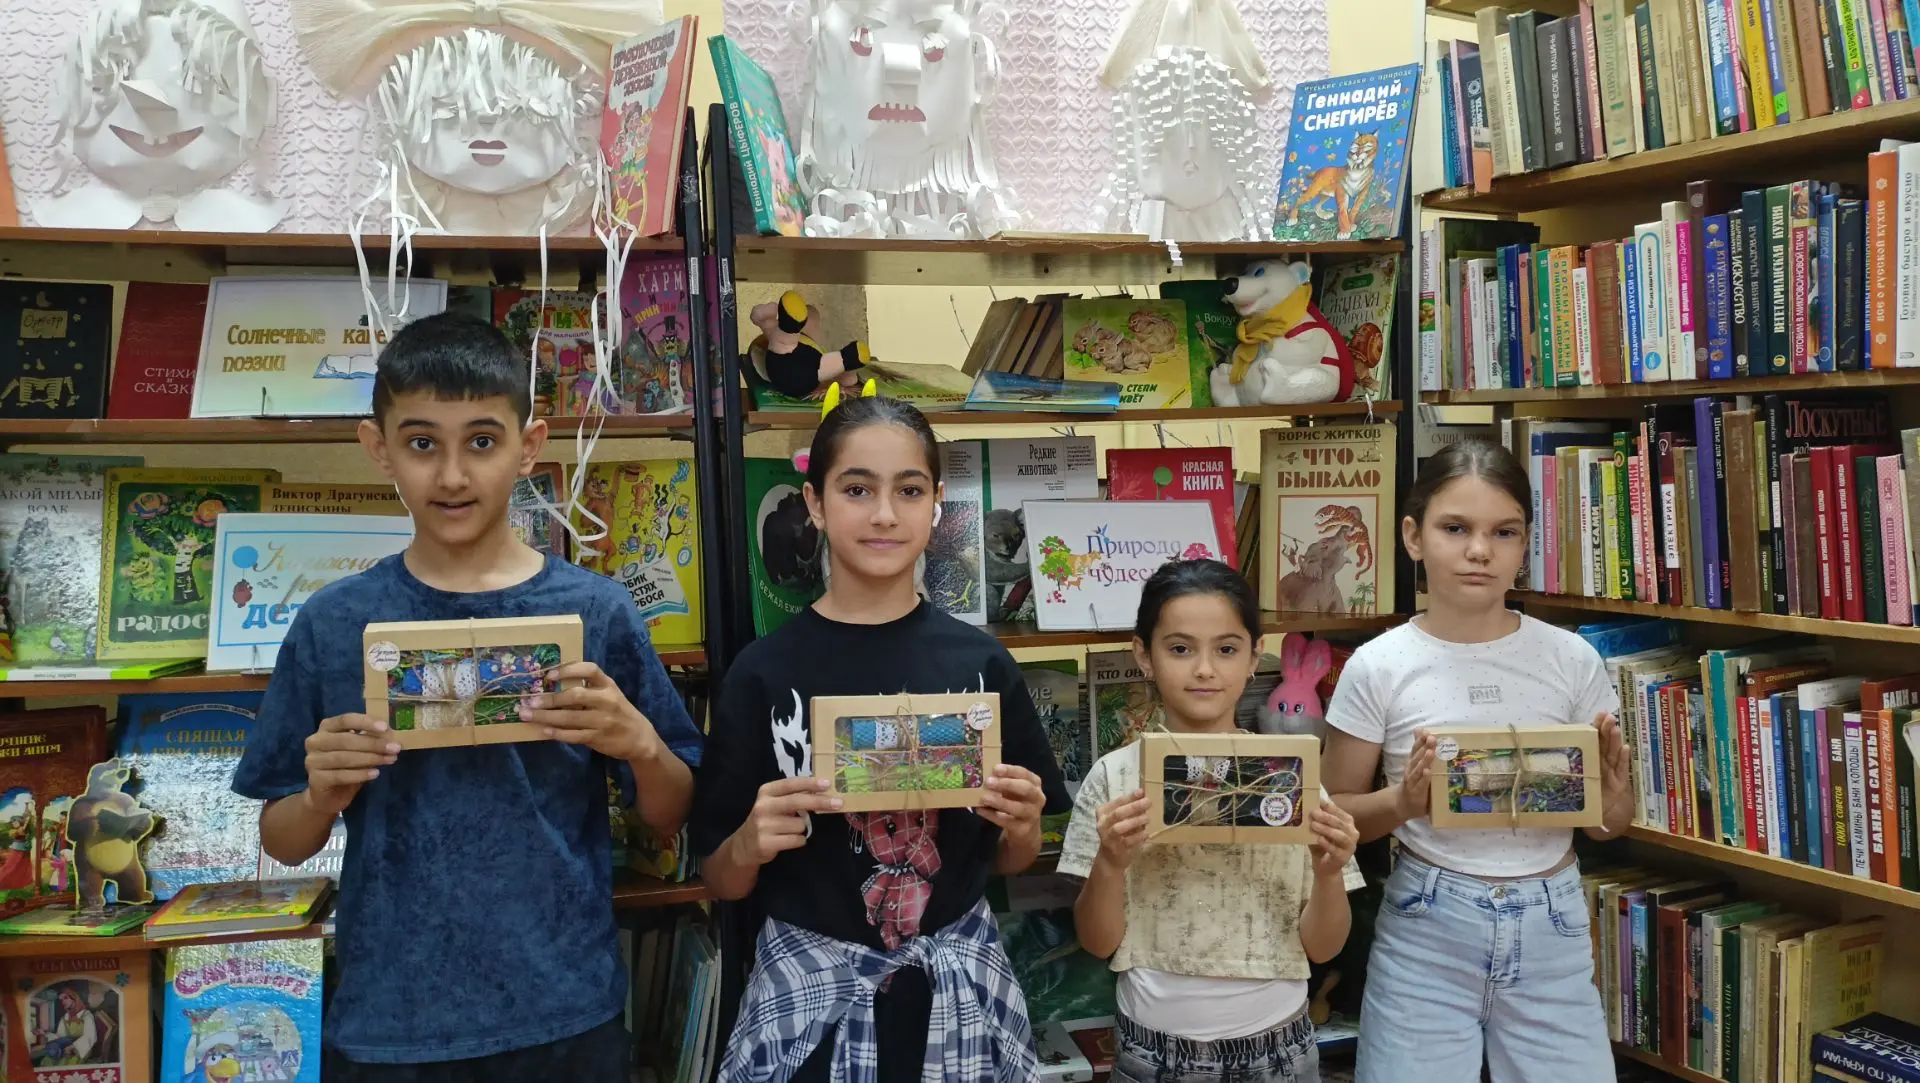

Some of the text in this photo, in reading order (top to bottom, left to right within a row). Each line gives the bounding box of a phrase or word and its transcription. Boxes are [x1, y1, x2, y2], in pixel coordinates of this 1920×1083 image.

[1602, 24, 1617, 100] СПРАВОЧНИК
[1306, 79, 1402, 110] Геннадий
[1549, 32, 1561, 134] ЭЛЕКТРИЧЕСКИЕ МАШИНЫ
[1304, 100, 1398, 131] СНЕГИРЁВ
[730, 101, 763, 213] Геннадий ЦЫФЕРОВ
[1902, 171, 1914, 212] вкусно
[1876, 198, 1887, 236] КУХНЕ
[1677, 227, 1687, 254] Дюкан
[1901, 228, 1912, 269] быстро
[1679, 256, 1687, 280] диеты
[1772, 204, 1784, 332] ВЕГЕТАРИАНСКАЯ КУХНЯ
[1875, 239, 1886, 288] РУССКОЙ
[638, 270, 684, 293] ХАРМ
[1627, 279, 1635, 313] ЗАКУСКИ
[1715, 249, 1729, 334] ЭНЦИКЛОПЕДИЯ
[1730, 255, 1746, 324] ИСКУССТВО
[1795, 251, 1804, 315] МИКРОВОЛНОВОЙ
[1330, 291, 1381, 313] ЖИВАЯ
[1899, 274, 1909, 320] Готовим
[1204, 313, 1237, 325] Вокруг
[226, 323, 326, 346] Солнечные
[1630, 314, 1639, 365] Праздничные
[1796, 322, 1804, 356] ГОТОВИМ
[145, 367, 197, 378] СТИХИ
[222, 354, 286, 373] поэзии
[134, 382, 194, 394] СКАЗК
[1127, 384, 1158, 393] СТЕПИ
[1278, 428, 1381, 441] БОРИС ЖИТКОВ
[1028, 443, 1058, 460] Редкие
[1182, 460, 1225, 473] КРАСНАЯ
[1302, 447, 1355, 466] ЧТО
[0, 487, 41, 500] АКОЙ
[1182, 475, 1225, 491] КНИГА
[1277, 469, 1381, 488] БЫВАЛО
[27, 503, 69, 515] ВОЛК
[271, 487, 321, 502] Виктор
[1591, 505, 1600, 544] САМИ
[1664, 489, 1675, 559] ЭЛЕКТРИКА
[1086, 534, 1182, 559] Природа
[1088, 565, 1152, 588] чудес
[1621, 568, 1630, 586] 3
[759, 579, 804, 616] БЕЖАЛ ЕЖИ
[242, 602, 304, 630] дет
[1096, 670, 1120, 680] КТО
[1882, 688, 1909, 708] БАНИ
[166, 728, 247, 743] СПЯЩАЯ
[1747, 696, 1765, 837] УЛИЧНЫЕ ПЕЧИ И БАРБЕКЮ
[1879, 717, 1896, 811] КОРОТКИЕ СТРИЖКИ
[1743, 768, 1753, 808] ВЫКРОЙКИ
[1866, 728, 1883, 853] БАНИ САУНЫ
[1848, 744, 1865, 868] ПЕЧИ КАМИНЫ БАНИ КОЛОДЦЫ
[1722, 982, 1732, 1062] АВТОМЕХАНИК
[1823, 1050, 1884, 1080] ПО КРАНАМ
